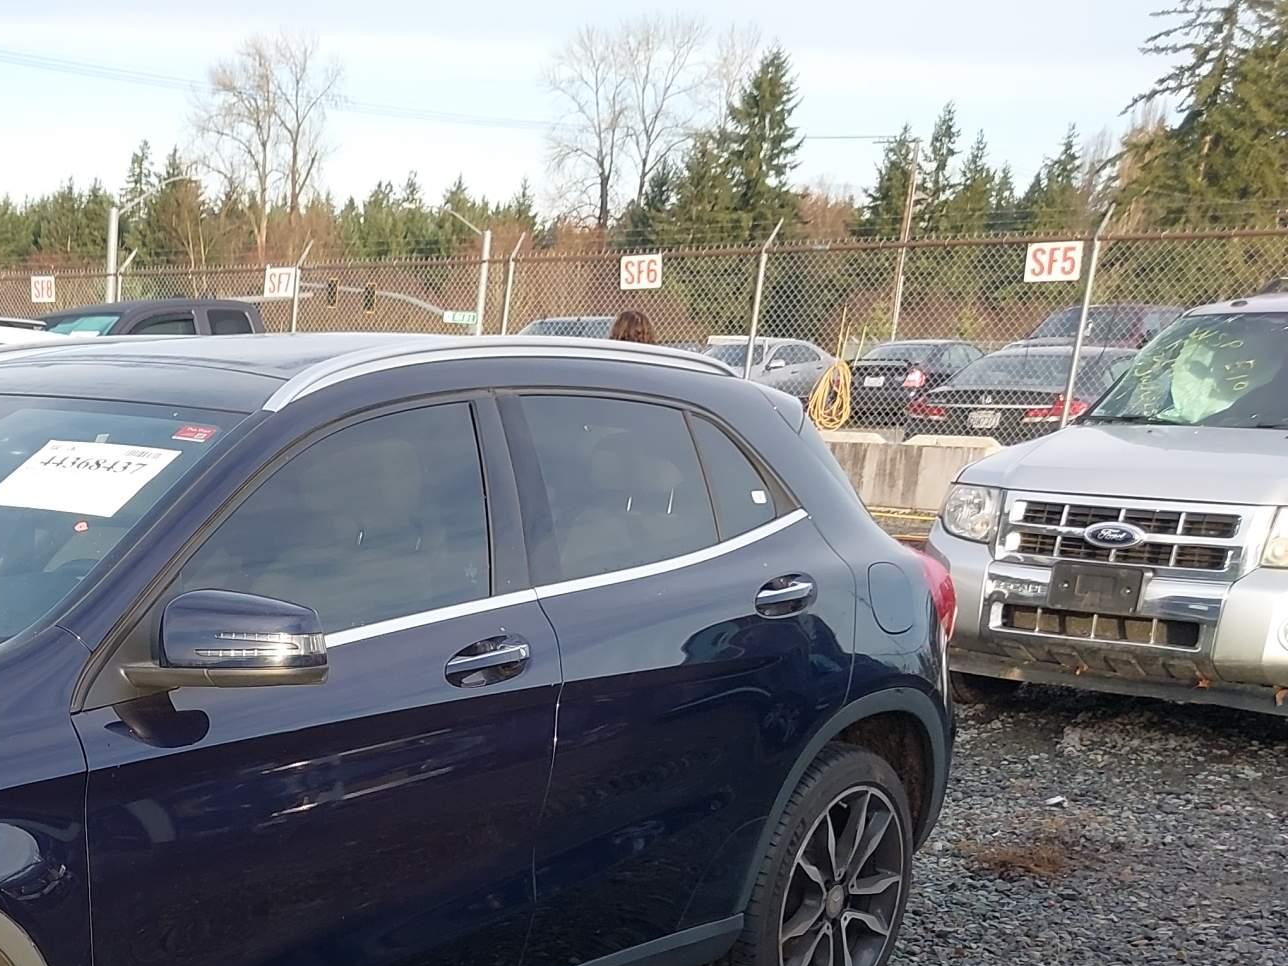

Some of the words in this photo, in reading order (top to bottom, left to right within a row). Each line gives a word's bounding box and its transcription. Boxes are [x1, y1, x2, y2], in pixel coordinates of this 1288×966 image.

[624, 259, 657, 284] SF6
[1031, 246, 1077, 276] SF5
[268, 272, 291, 294] SF7
[39, 456, 149, 474] 44368437
[1096, 528, 1128, 540] Ford
